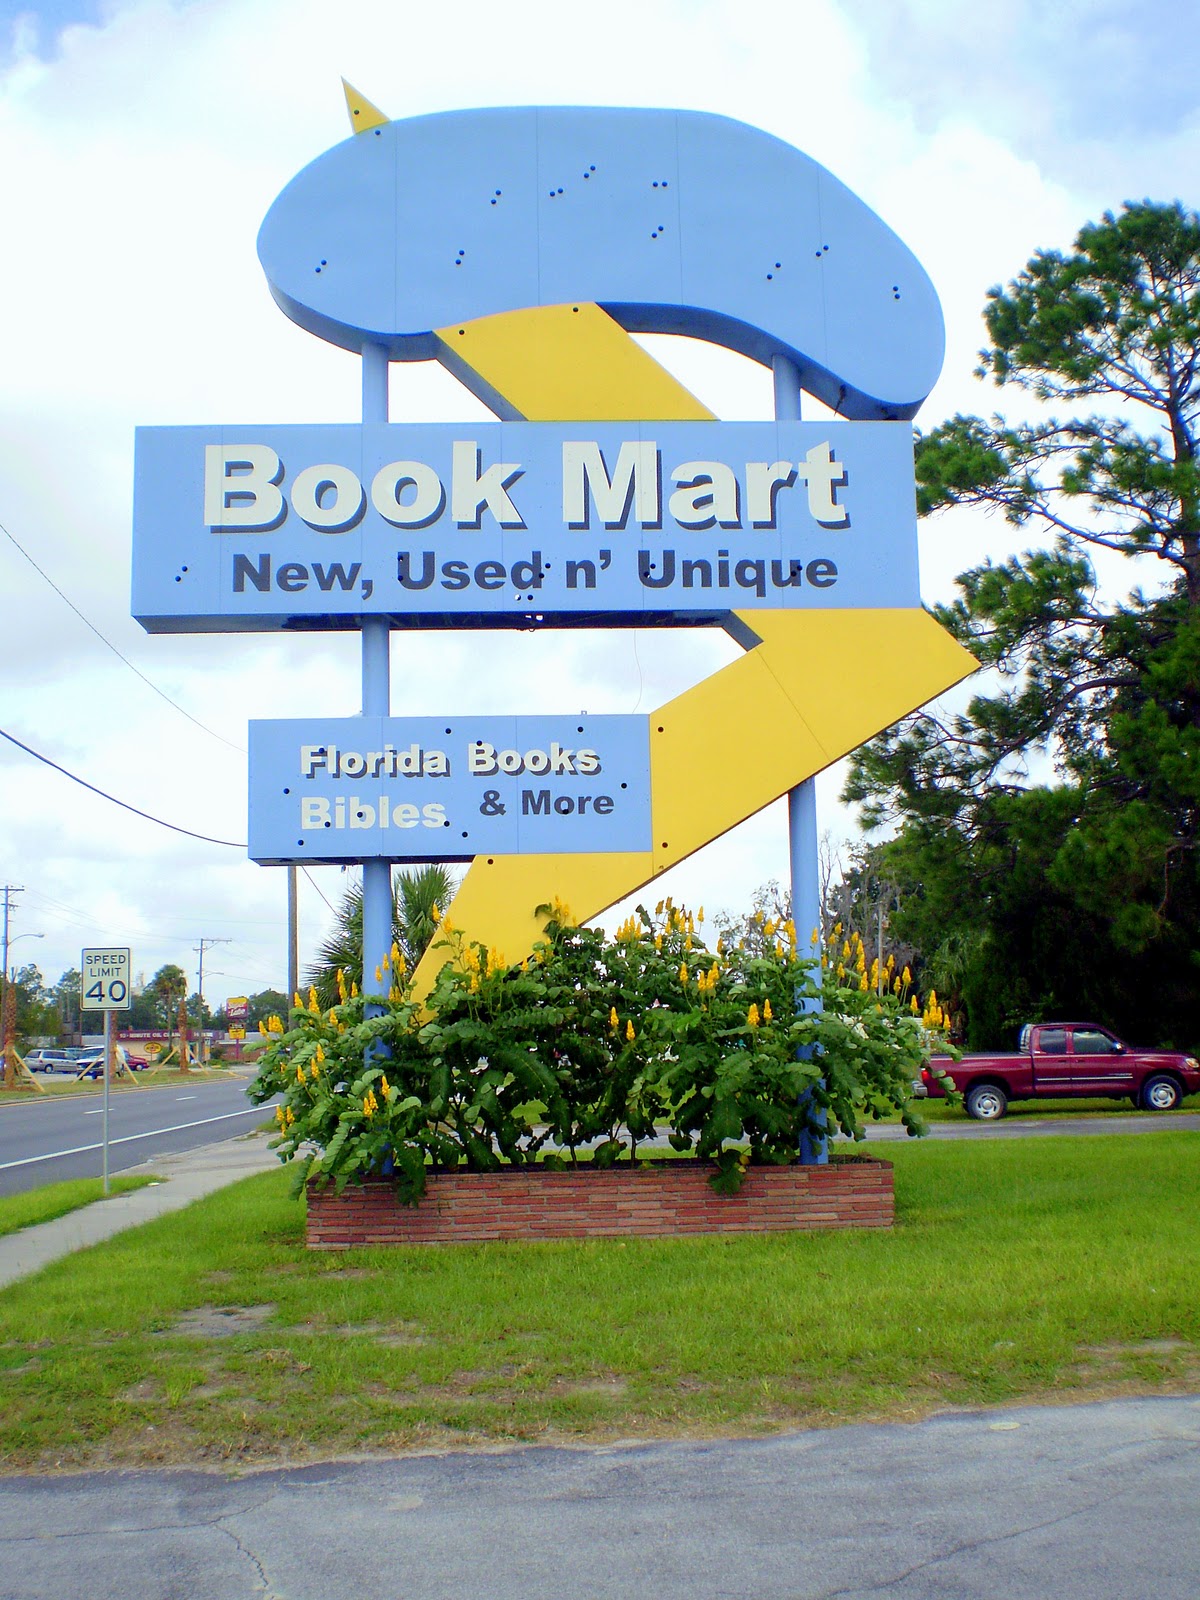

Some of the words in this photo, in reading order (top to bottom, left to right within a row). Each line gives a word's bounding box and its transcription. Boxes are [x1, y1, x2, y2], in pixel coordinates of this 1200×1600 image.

[204, 441, 527, 532] Book
[562, 440, 850, 532] Mart
[232, 553, 374, 599] New,
[397, 550, 543, 590] Used
[639, 549, 838, 597] Unique
[300, 744, 450, 779] Florida
[467, 742, 600, 775] Books
[300, 797, 449, 831] Bibles
[479, 790, 506, 816] &
[521, 790, 615, 816] More
[86, 955, 126, 965] SPEED
[89, 967, 121, 977] LIMIT
[85, 980, 127, 1002] 40
